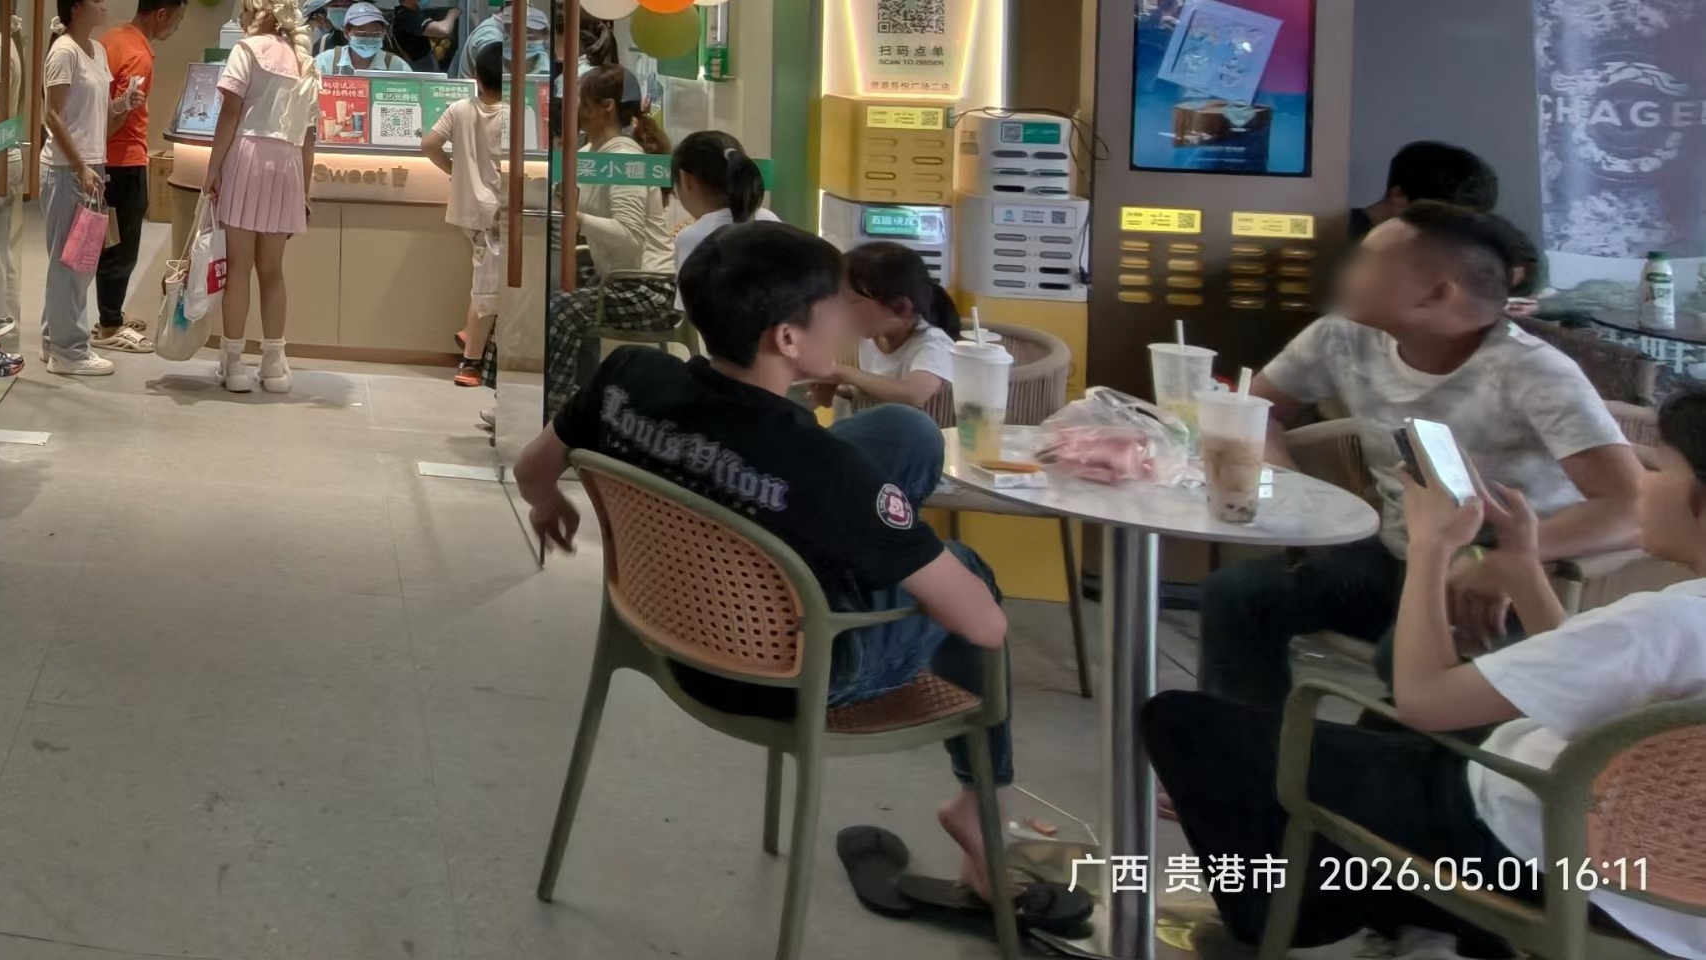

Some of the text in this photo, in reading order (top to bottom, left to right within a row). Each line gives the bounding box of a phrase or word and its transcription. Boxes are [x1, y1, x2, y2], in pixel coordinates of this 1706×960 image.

[878, 45, 943, 56] 扫码点单
[1539, 95, 1706, 128] CHAGE
[313, 163, 387, 186] Sweet
